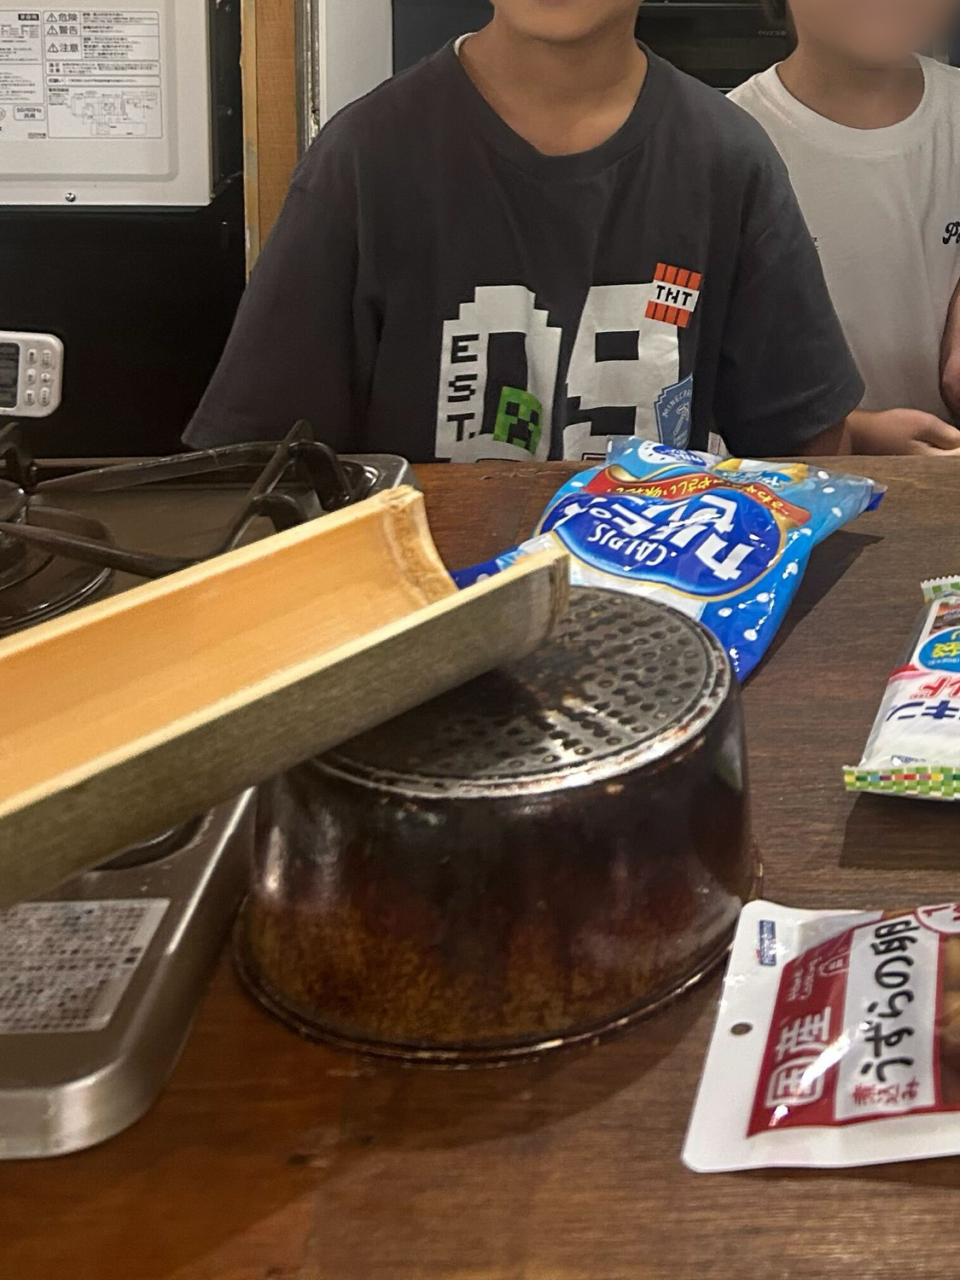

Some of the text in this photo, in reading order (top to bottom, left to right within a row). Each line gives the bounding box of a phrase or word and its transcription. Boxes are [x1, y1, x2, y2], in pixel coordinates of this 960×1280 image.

[58, 13, 78, 22] 危険
[59, 25, 78, 35] 警告
[59, 43, 79, 53] 注意
[655, 284, 693, 307] TNT
[587, 522, 668, 566] CALPIS
[860, 920, 920, 1083] うずらの卵
[764, 1006, 832, 1108] 国産
